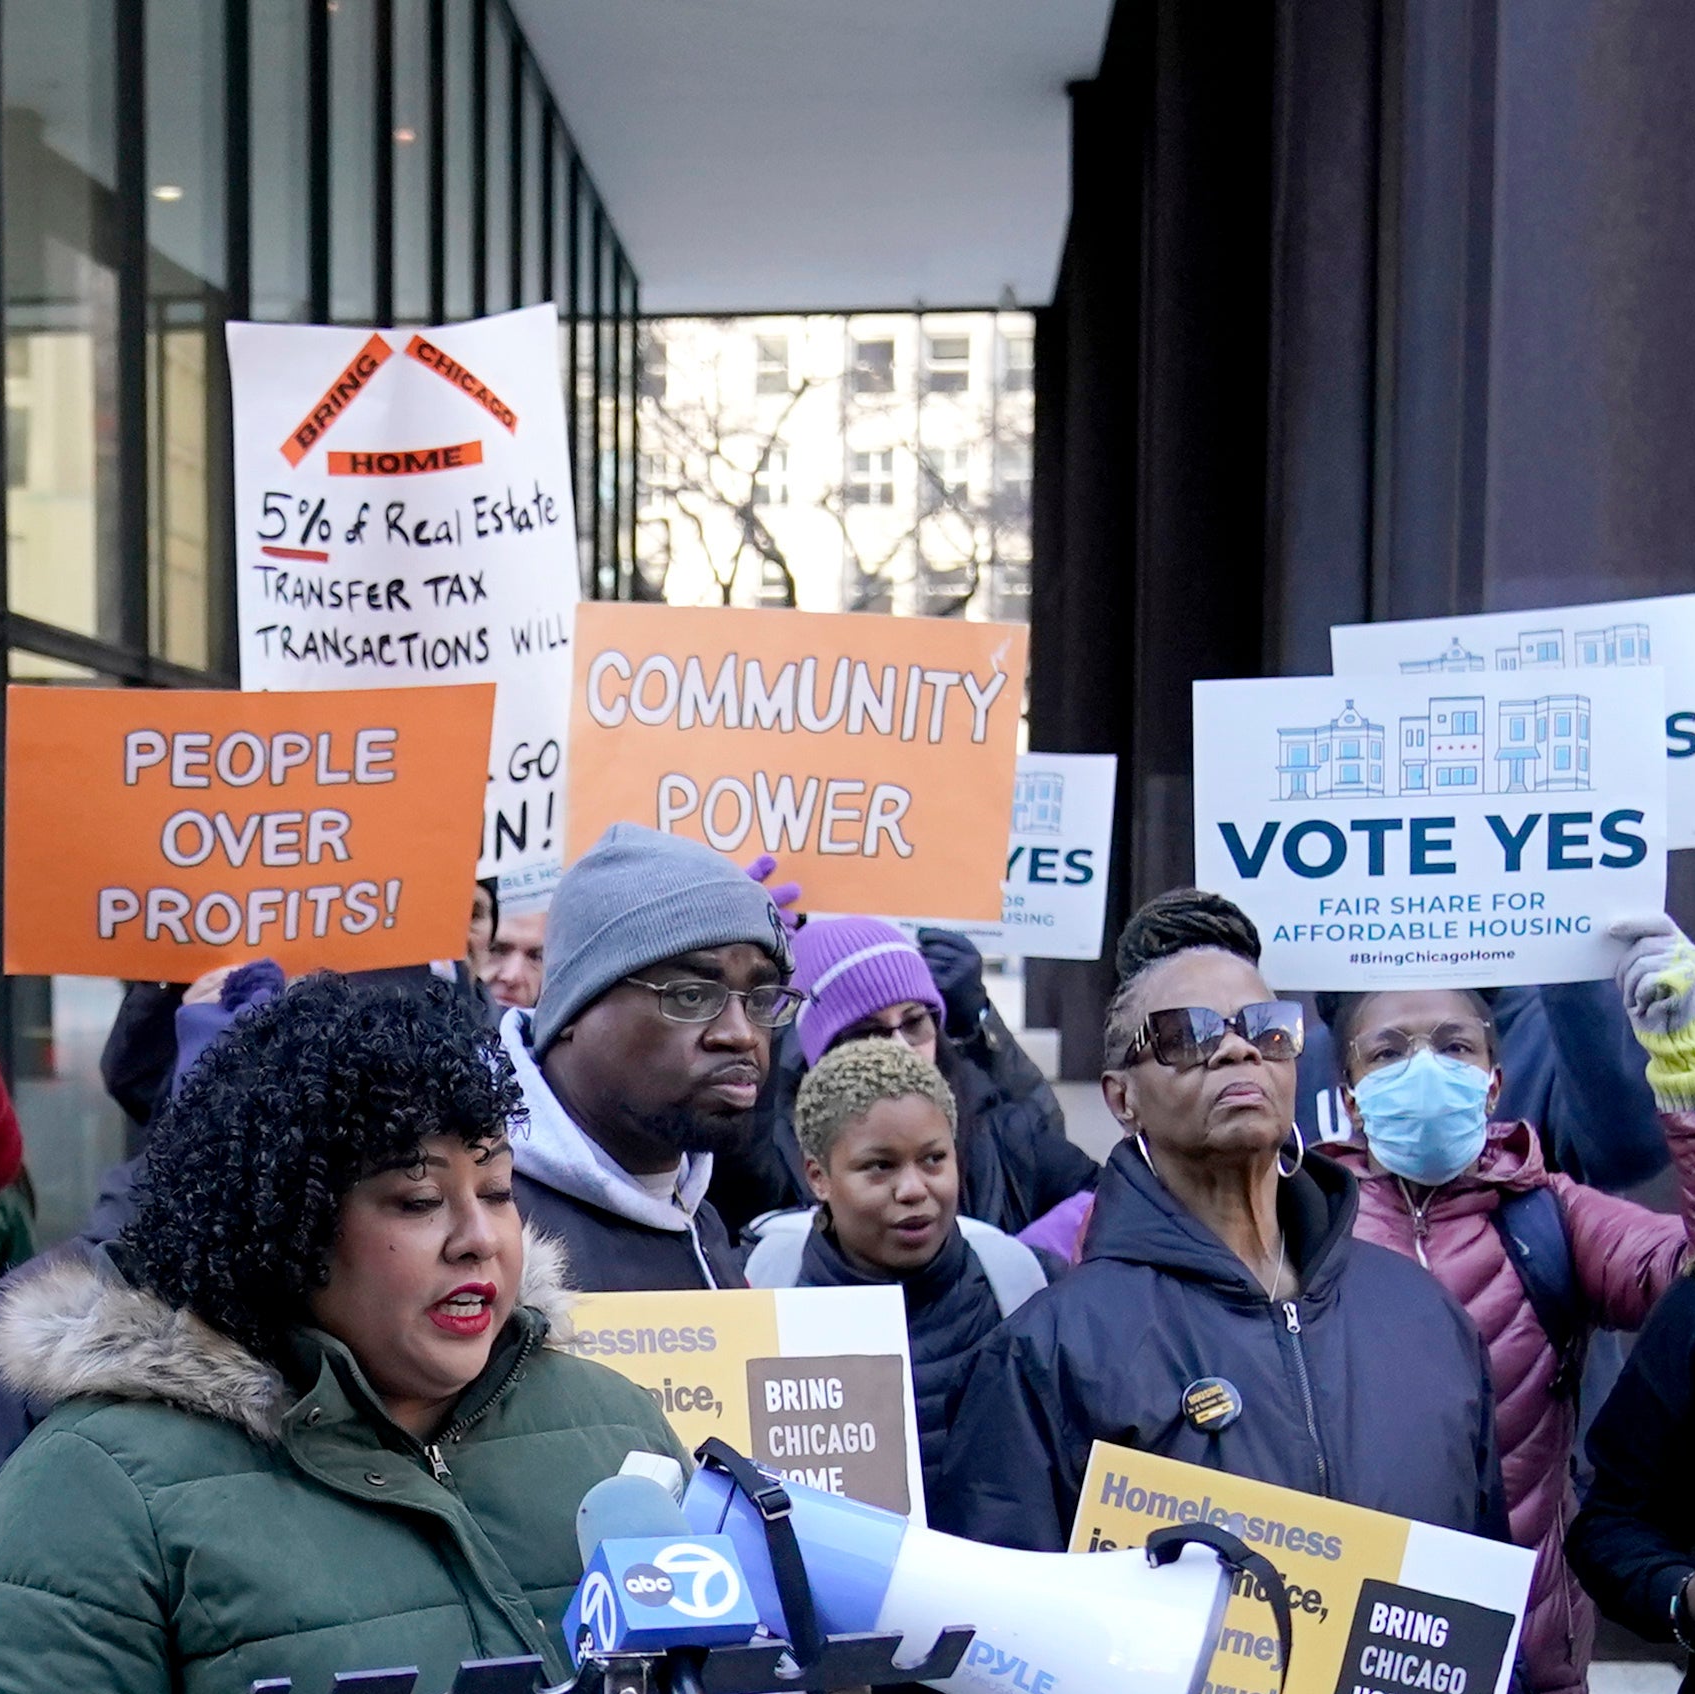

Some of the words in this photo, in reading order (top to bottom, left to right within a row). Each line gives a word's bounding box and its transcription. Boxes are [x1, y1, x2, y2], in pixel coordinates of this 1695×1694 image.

[295, 354, 379, 450] BRING
[416, 342, 516, 429] CHICAGO
[350, 446, 464, 475] HOME
[257, 492, 332, 546] 5%
[345, 502, 370, 544] of
[385, 501, 462, 547] Real
[472, 479, 560, 537] Estate
[252, 565, 411, 612] TRANSFER
[423, 571, 488, 607] TAX
[256, 625, 490, 670] TRANSACTIONS
[510, 613, 569, 656] WILL
[587, 650, 1006, 744] COMMUNITY
[123, 728, 399, 789] PEOPLE
[509, 740, 560, 783] GO
[160, 808, 352, 868] OVER
[477, 792, 554, 862] N!
[657, 770, 914, 858] POWER
[1218, 817, 1456, 880] VOTE
[1485, 809, 1648, 873] YES
[97, 878, 402, 947] PROFITS!
[1273, 921, 1458, 943] AFFORDABLE
[1468, 916, 1592, 939] HOUSING
[1318, 896, 1381, 916] FAIR
[1390, 894, 1482, 915] SHARE
[1491, 892, 1546, 911] FOR
[1349, 947, 1516, 967] #BringChicagoHome
[764, 1378, 843, 1412] BRING
[769, 1422, 875, 1457] CHICAGO
[626, 1575, 672, 1593] abc
[653, 1543, 740, 1619] 7
[1369, 1602, 1449, 1648] BRING
